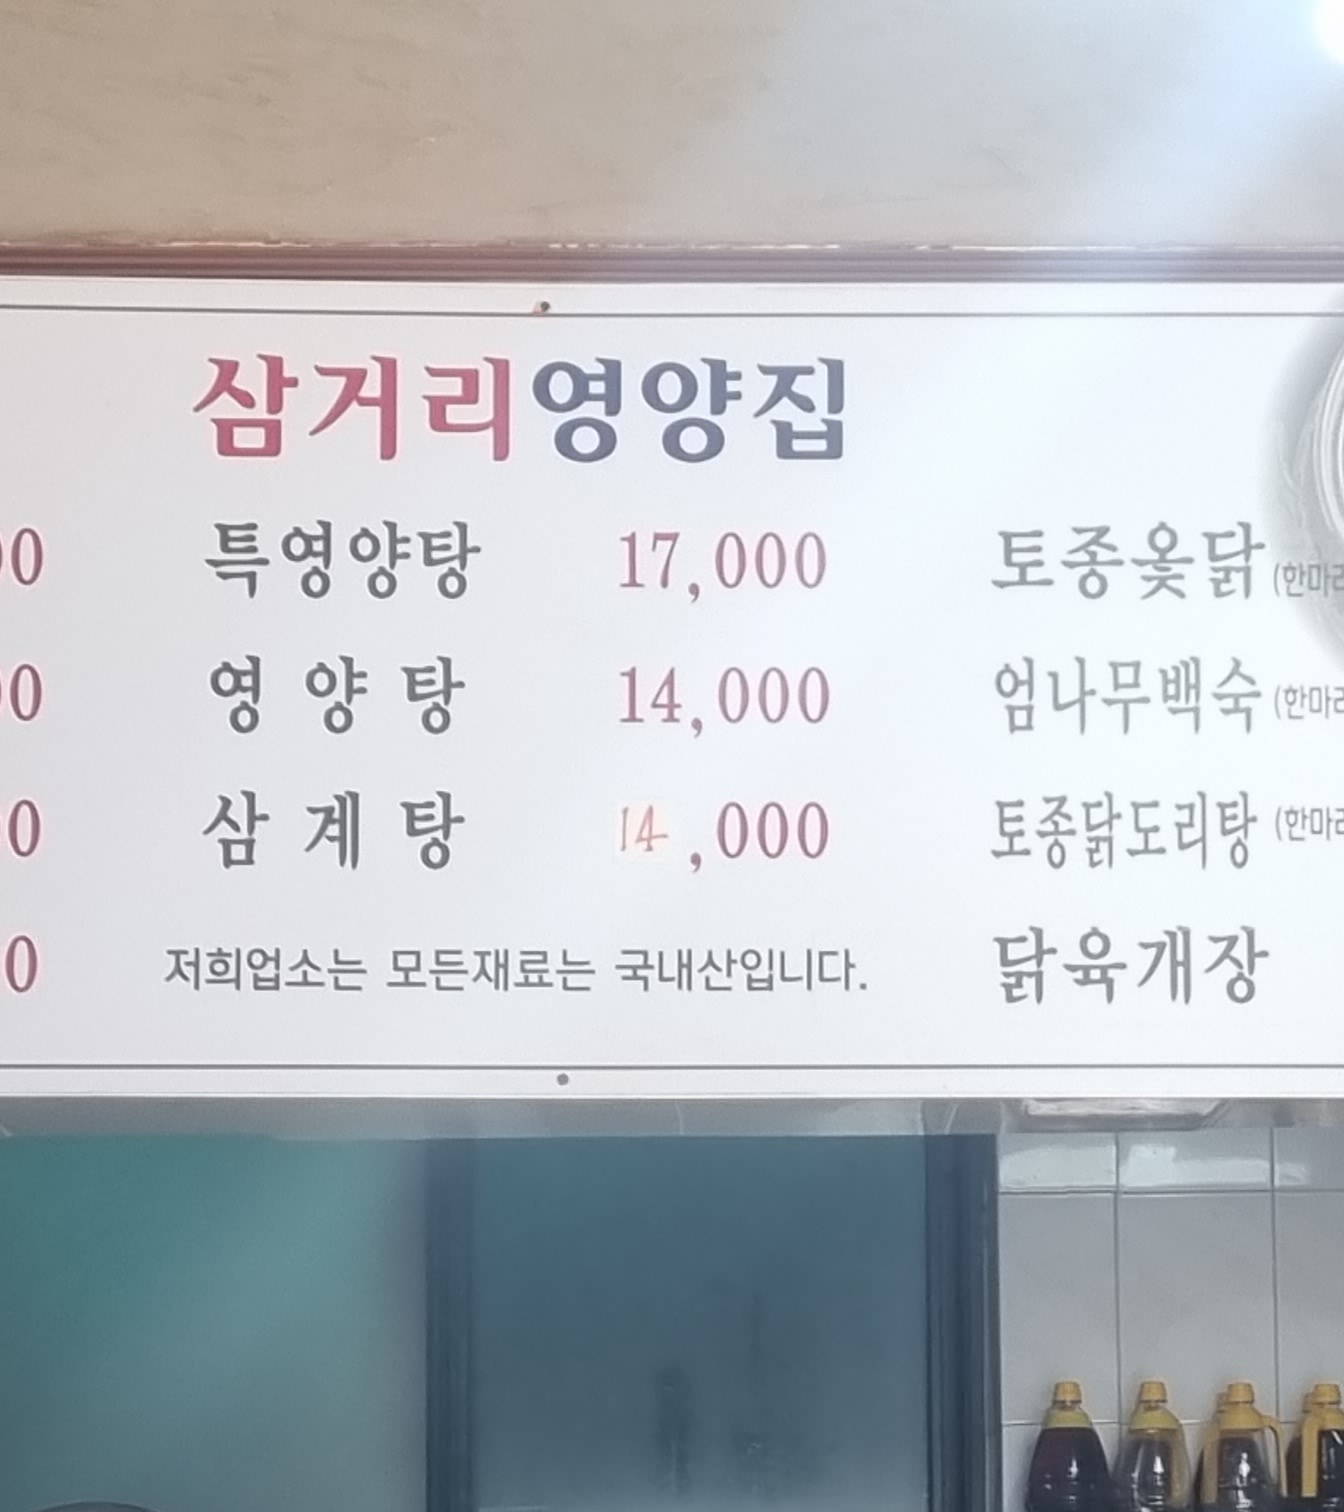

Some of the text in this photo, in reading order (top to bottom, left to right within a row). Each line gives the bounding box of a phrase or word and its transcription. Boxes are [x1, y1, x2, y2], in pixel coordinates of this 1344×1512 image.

[193, 354, 846, 463] 삼거리영양집
[204, 520, 826, 602] 특영양탕 17,000
[619, 666, 830, 737] 14,000
[994, 657, 1263, 734] 엄나무백숙
[618, 801, 830, 872] 14,000
[990, 791, 1257, 870] 토종닭도리탕
[164, 946, 868, 993] 저희업소는 모든재료는 국내산입니다.
[992, 926, 1270, 1005] 닭육개장
